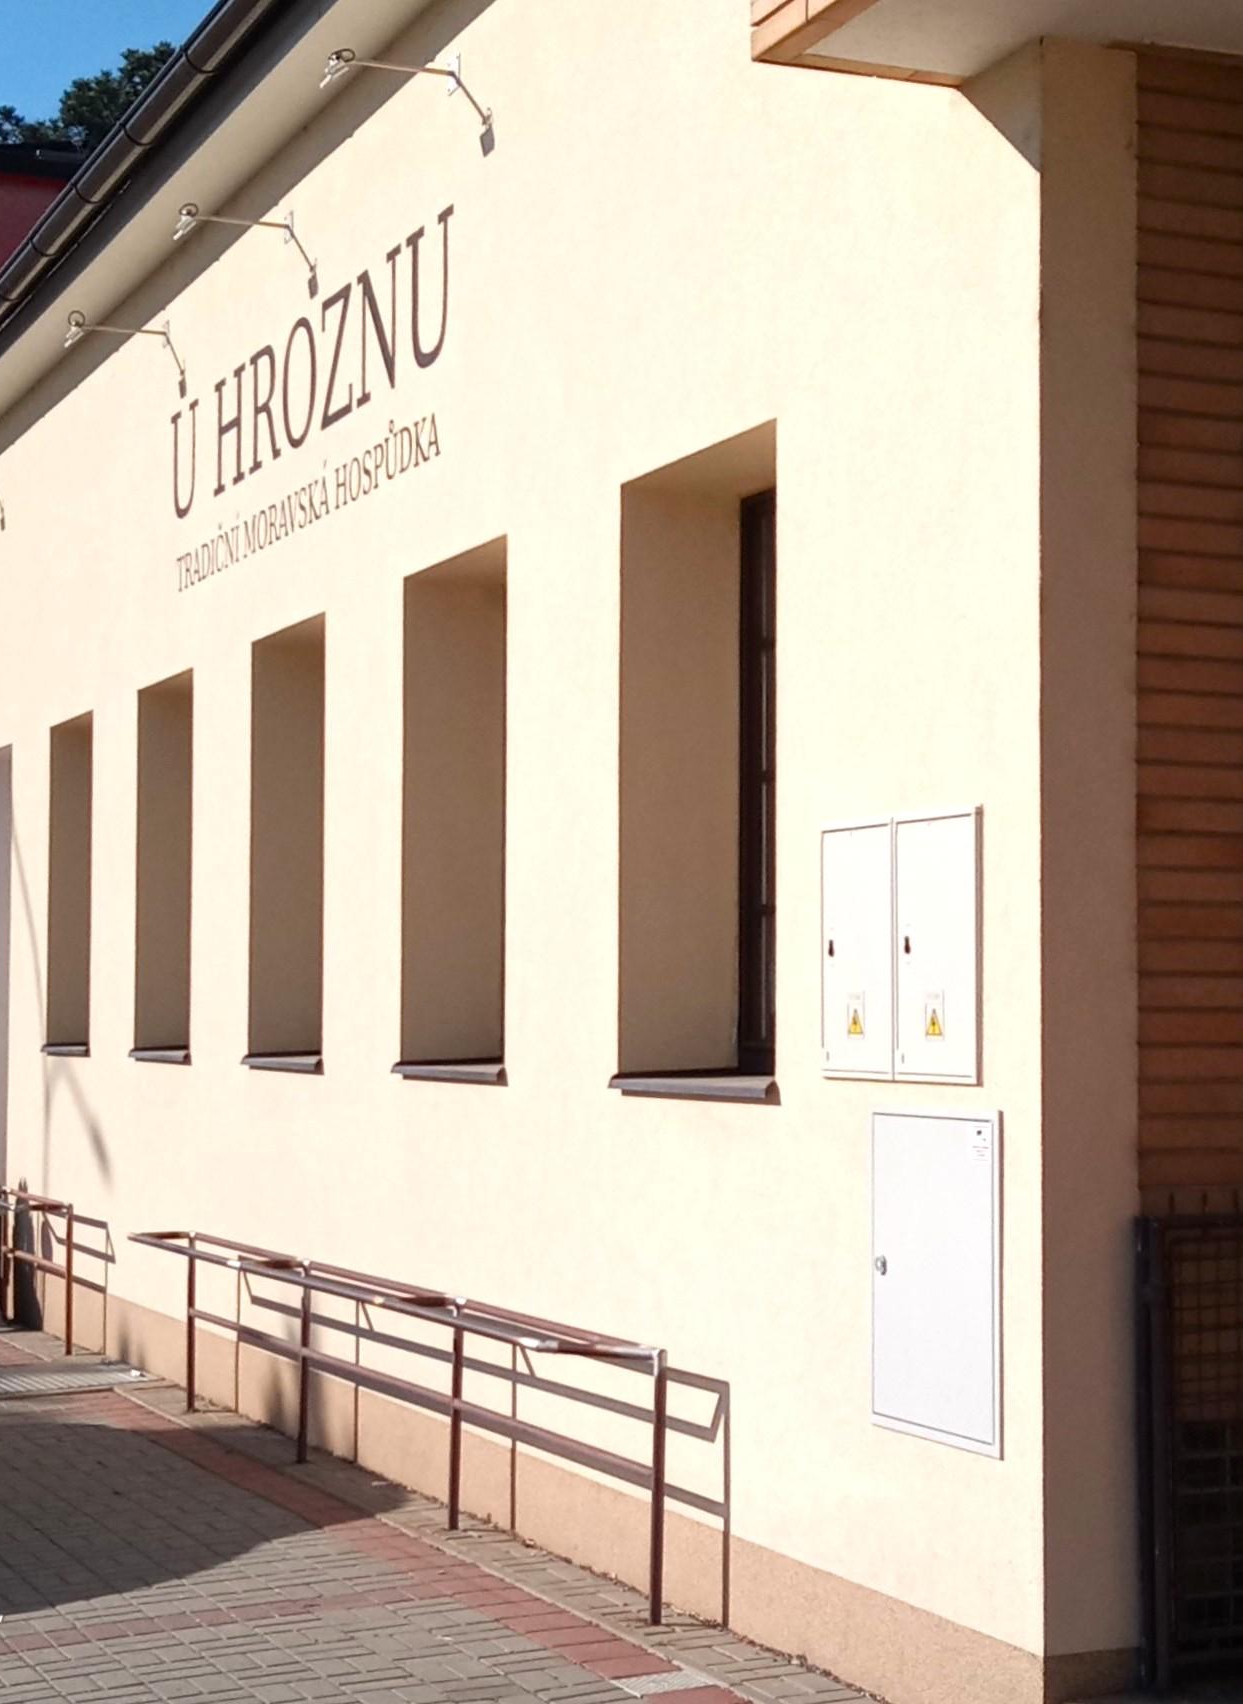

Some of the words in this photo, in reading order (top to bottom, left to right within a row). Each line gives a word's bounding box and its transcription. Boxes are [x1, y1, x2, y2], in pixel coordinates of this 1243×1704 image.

[170, 398, 199, 519] U
[213, 203, 454, 498] HROZNU
[176, 511, 240, 593] TRADIČNÍ
[243, 460, 330, 558] MORAVSKÁ
[335, 412, 441, 509] HOSPŮDKA
